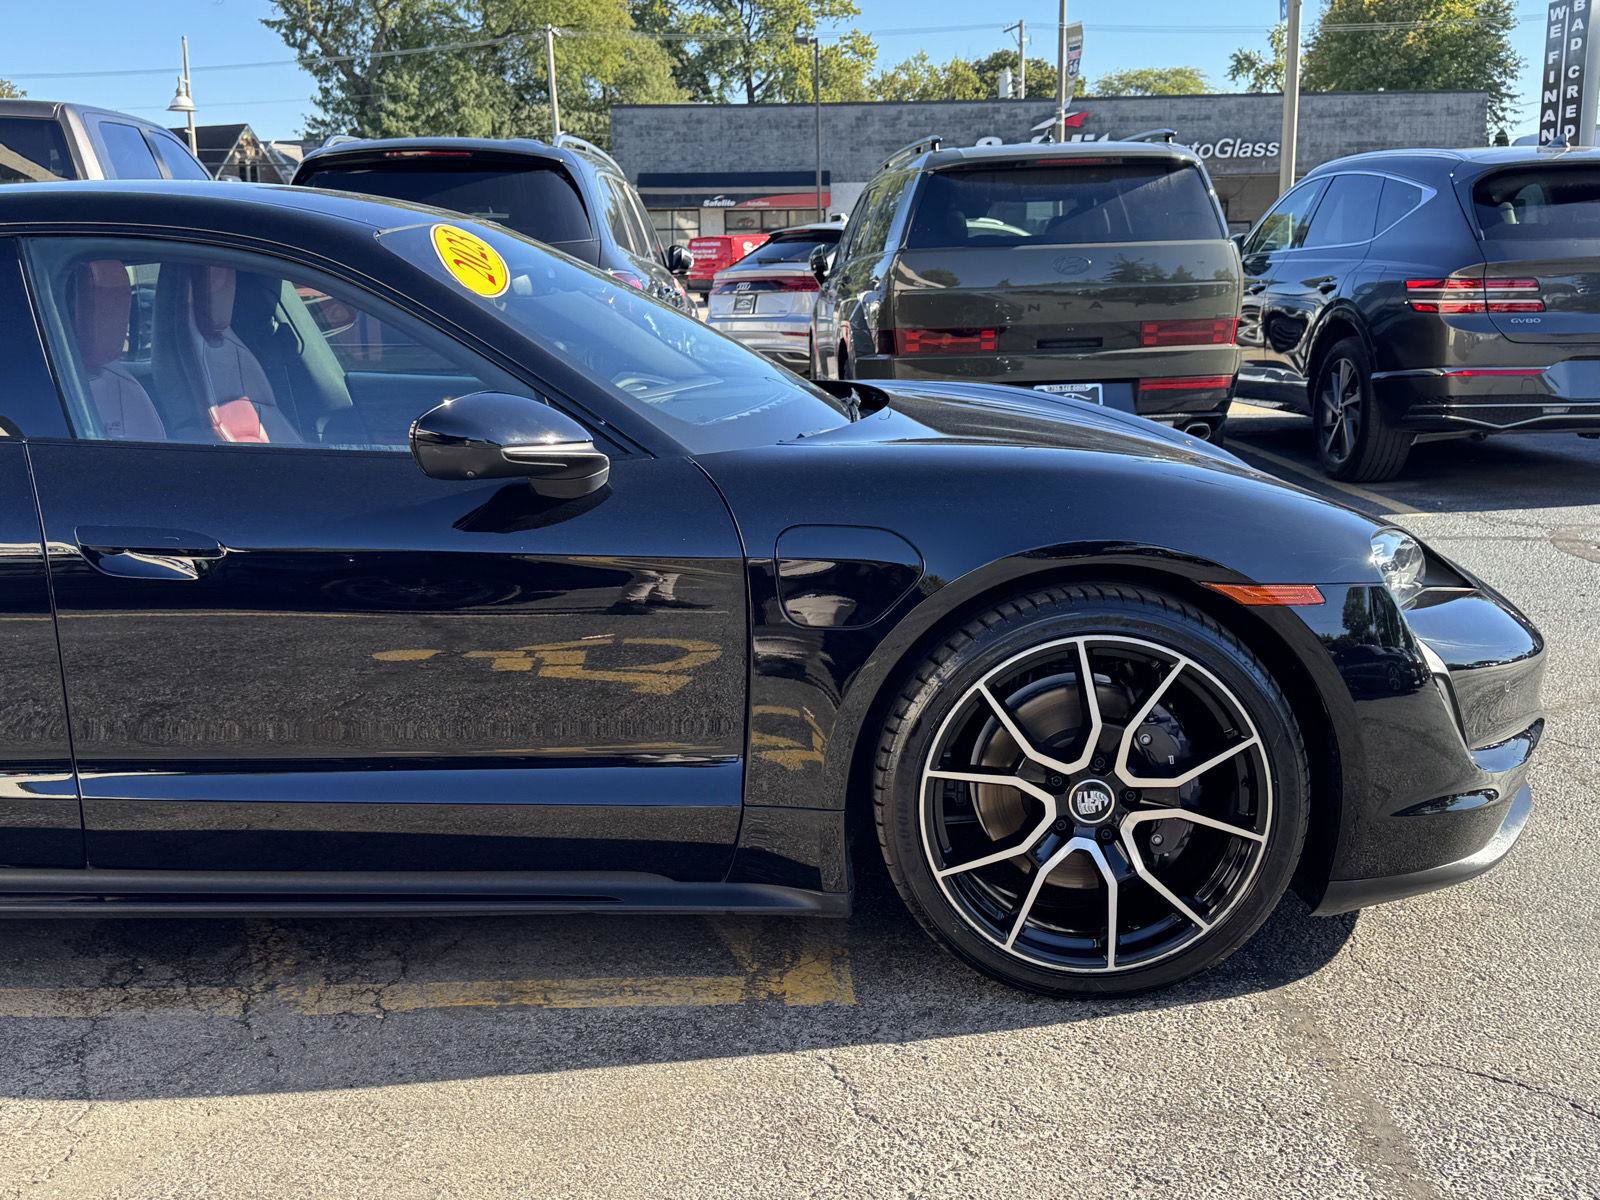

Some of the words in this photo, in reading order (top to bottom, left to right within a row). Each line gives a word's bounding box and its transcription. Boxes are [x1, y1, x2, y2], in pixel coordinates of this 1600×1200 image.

[1549, 5, 1567, 39] WE
[1570, 0, 1587, 51] BAD
[1192, 137, 1280, 158] toGlass
[703, 199, 736, 207] Safelite
[441, 228, 497, 287] 2023
